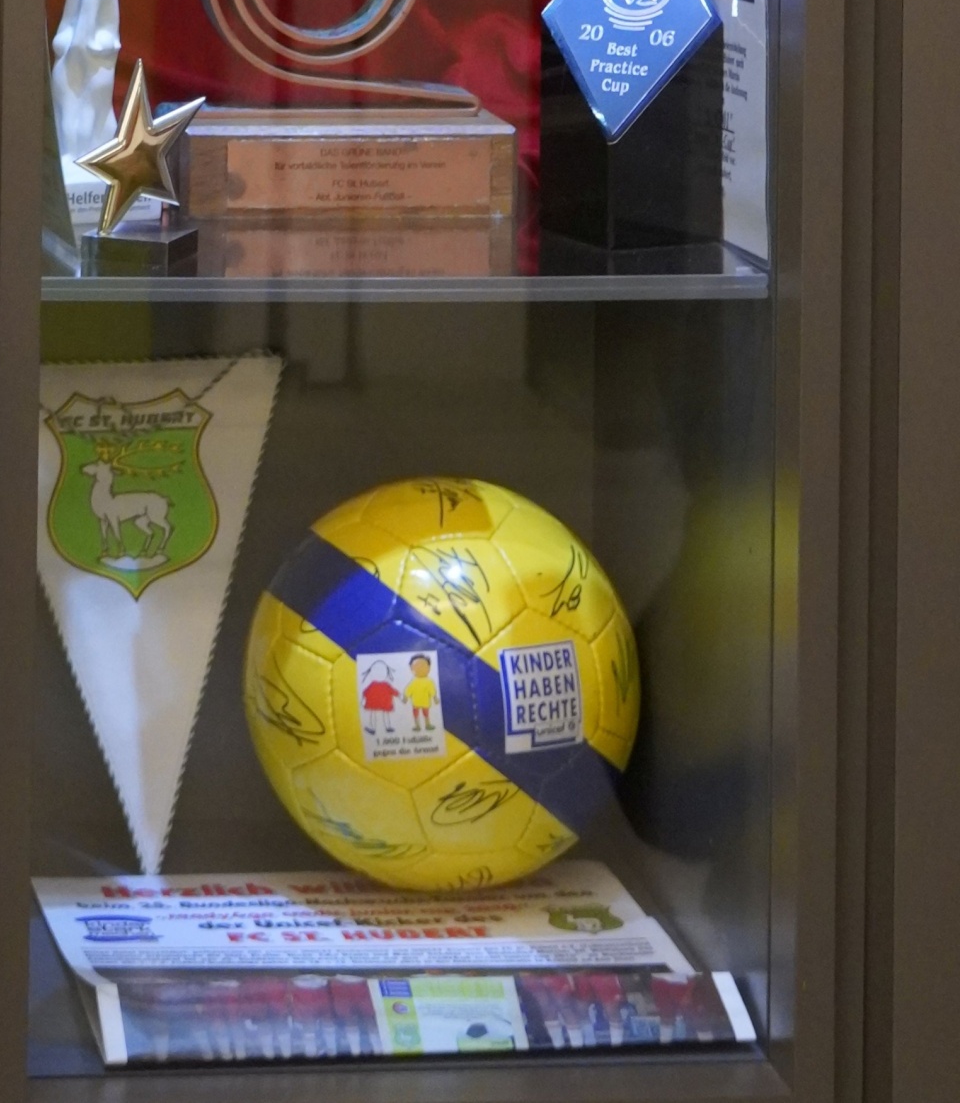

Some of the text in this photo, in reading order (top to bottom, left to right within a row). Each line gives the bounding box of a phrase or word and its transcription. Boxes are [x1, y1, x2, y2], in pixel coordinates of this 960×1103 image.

[578, 24, 675, 46] 20 06
[606, 42, 638, 57] Best
[590, 59, 648, 77] Practice
[601, 78, 630, 97] Cup
[510, 648, 573, 675] KINDER
[513, 673, 575, 700] HABEN
[516, 698, 577, 724] RECHTE
[101, 882, 275, 898] Herzlich
[227, 931, 269, 943] FC
[342, 925, 488, 941] HUBERT
